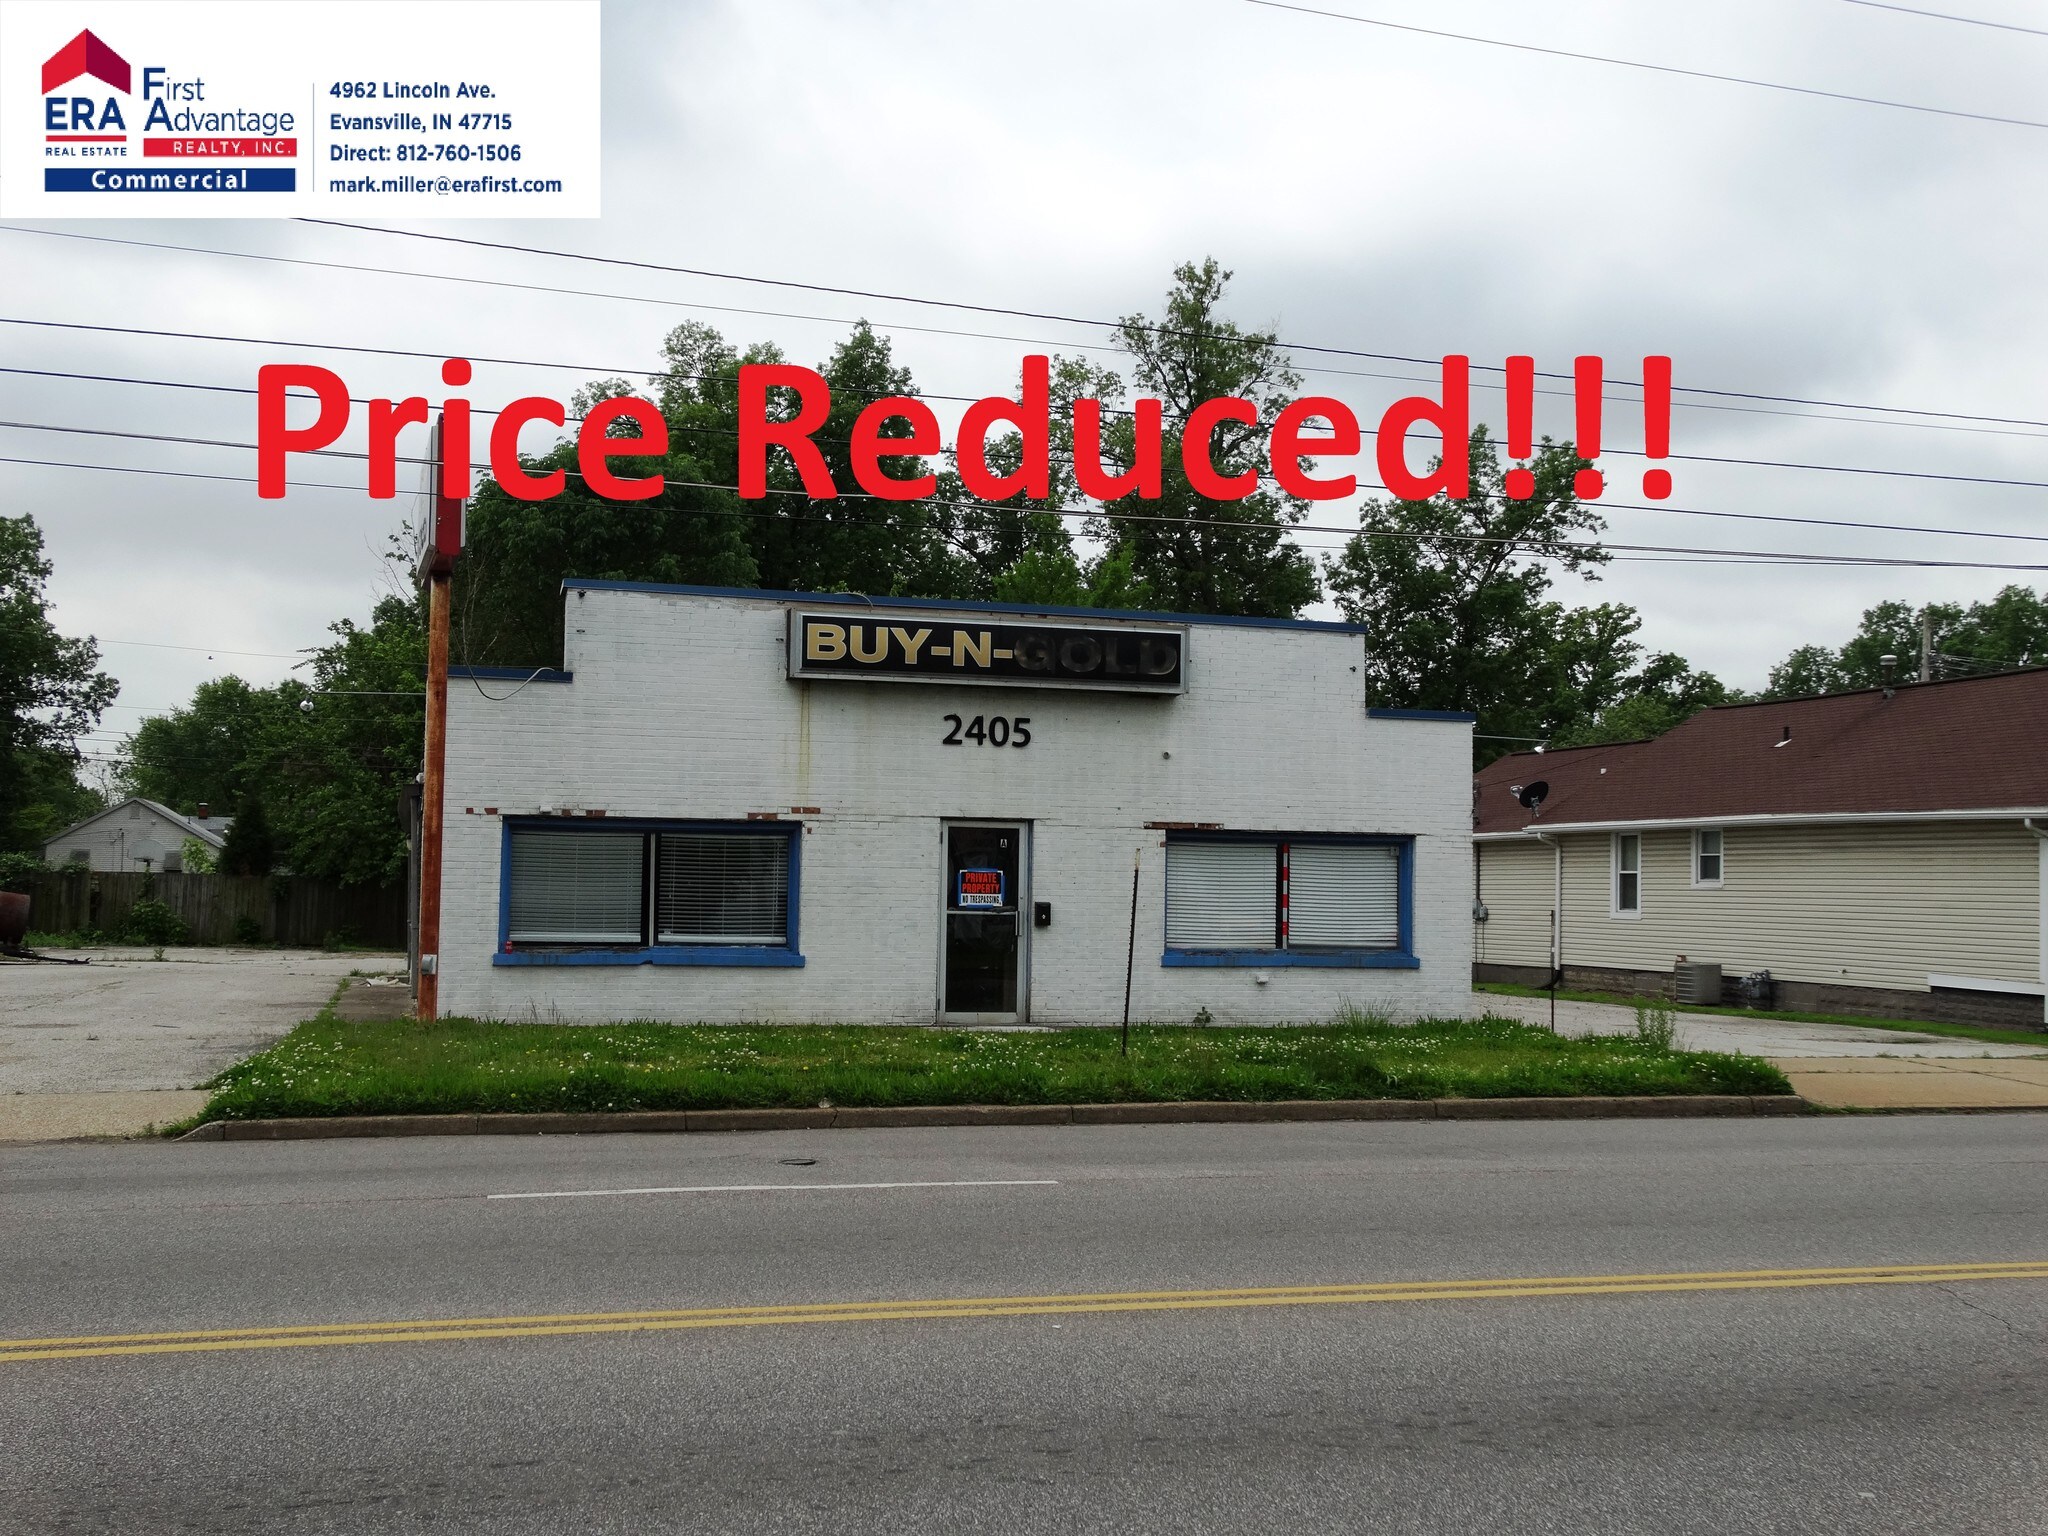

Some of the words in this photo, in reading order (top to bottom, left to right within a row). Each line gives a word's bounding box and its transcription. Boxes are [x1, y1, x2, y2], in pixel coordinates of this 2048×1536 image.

[942, 714, 1031, 748] 2405
[965, 873, 997, 883] PRIVATE
[962, 884, 1000, 893] PROPERTY
[962, 895, 969, 904] NO
[970, 895, 1000, 904] TRESPASSING
